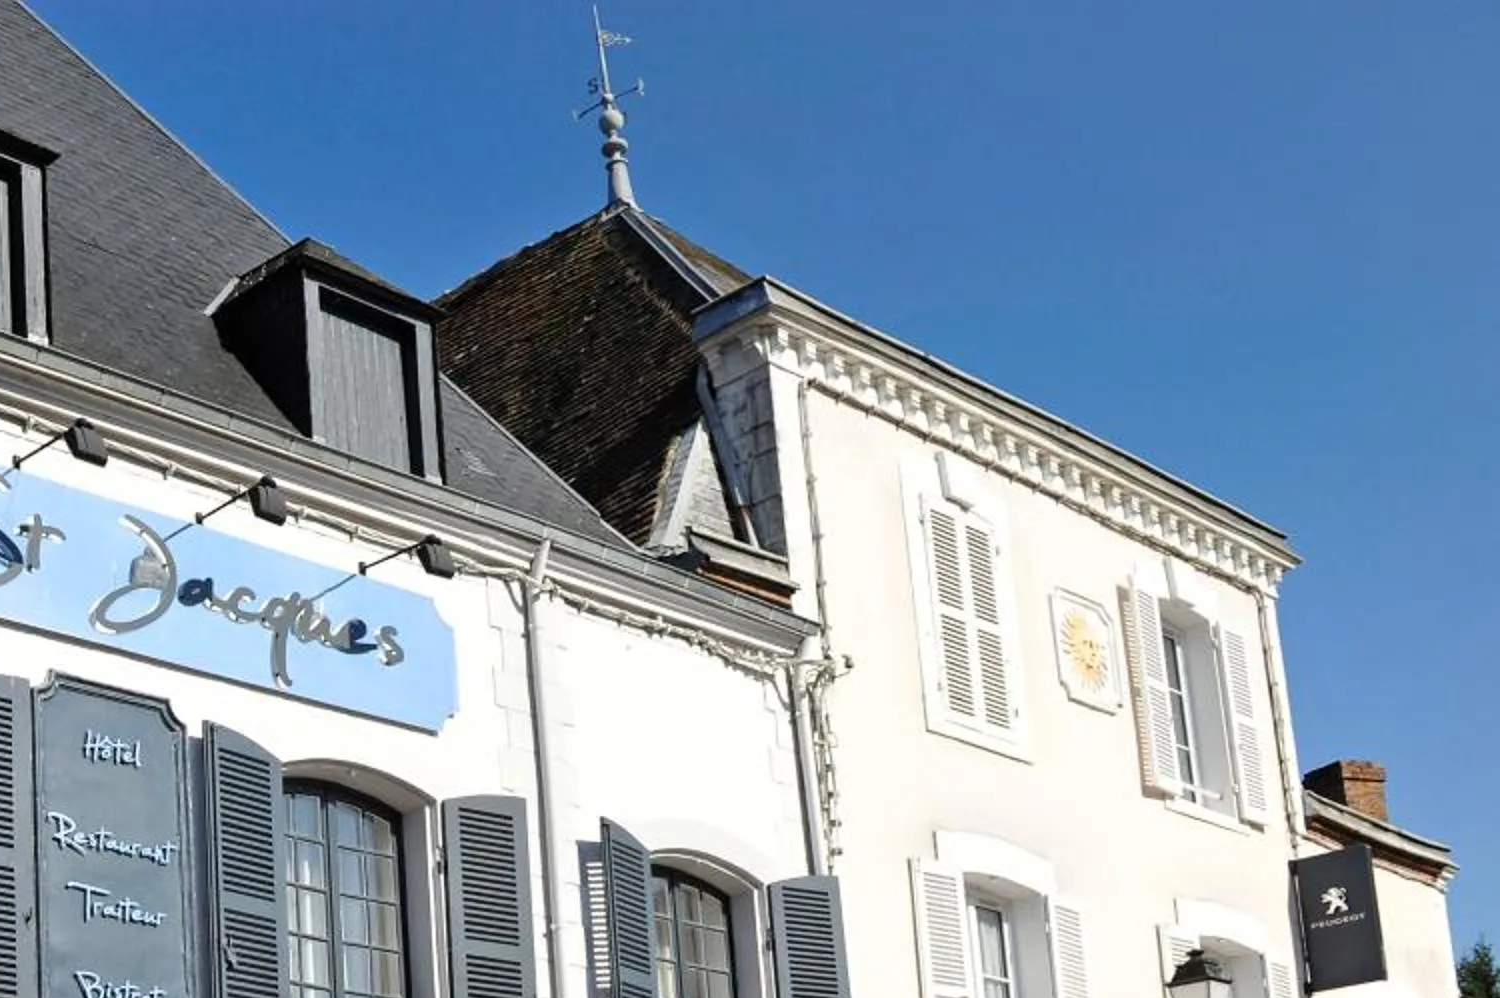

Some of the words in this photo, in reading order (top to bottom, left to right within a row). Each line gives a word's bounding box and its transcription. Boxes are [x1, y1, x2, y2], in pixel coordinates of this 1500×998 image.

[88, 514, 407, 690] Jacques
[83, 729, 142, 769] Hôtel
[47, 811, 178, 866] Restaurant
[66, 881, 167, 928] Traiteur
[1311, 911, 1366, 929] PEUGEOT
